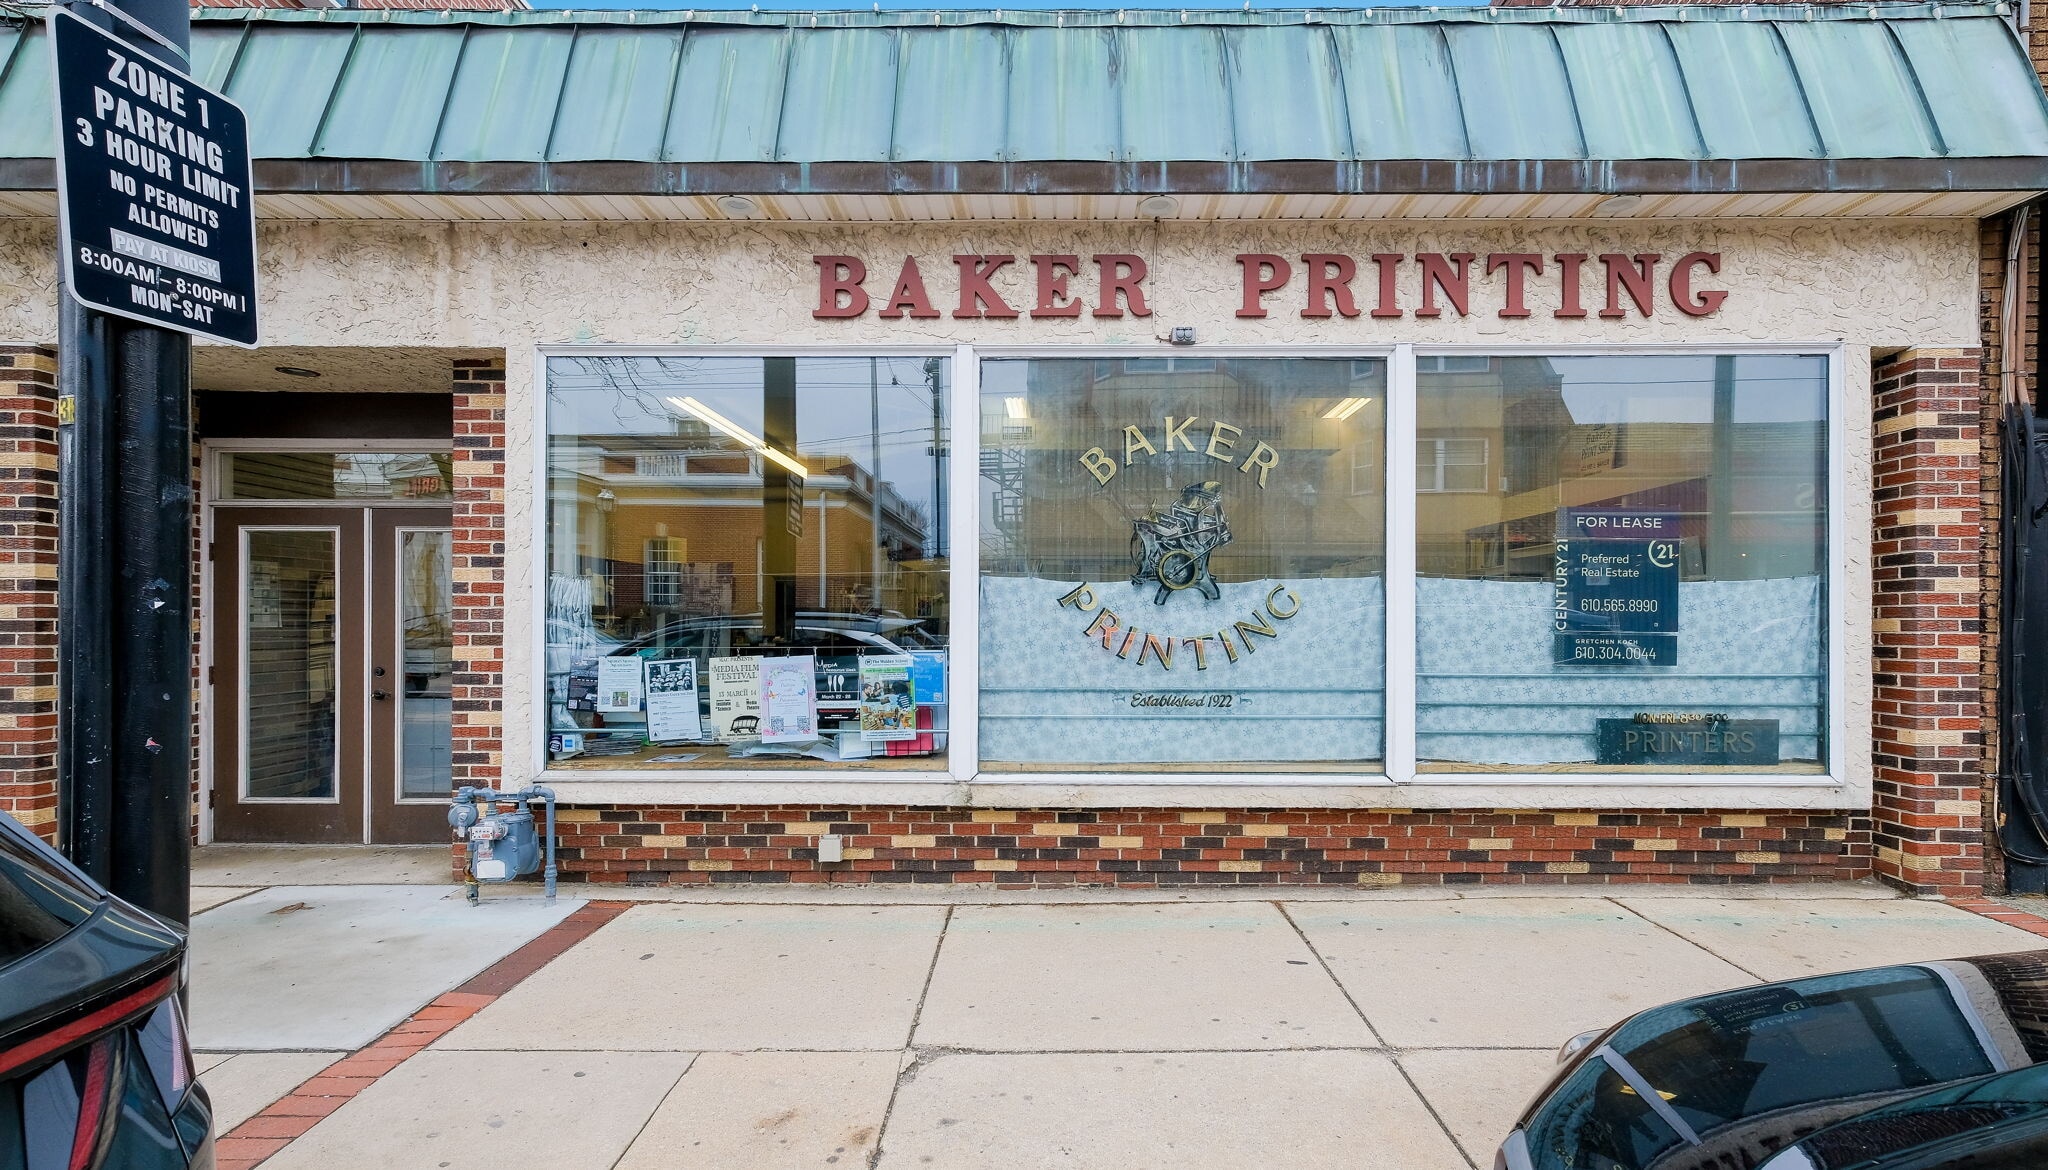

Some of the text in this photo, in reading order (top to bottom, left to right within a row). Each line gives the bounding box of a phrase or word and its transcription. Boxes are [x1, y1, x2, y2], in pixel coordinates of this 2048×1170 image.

[107, 49, 209, 129] ZONE 1
[94, 86, 224, 174] PARKING
[76, 117, 240, 208] 3 HOUR LIMIT
[110, 169, 219, 229] NO PERMITS
[128, 203, 208, 248] ALLOWED
[113, 233, 219, 279] PAY AT KIOSK
[80, 247, 155, 285] 8:00AM
[176, 278, 236, 310] 8:00PM
[812, 251, 1729, 318] BAKER PRINTING
[131, 284, 214, 324] MON-SAT
[1079, 415, 1280, 489] BAKER
[1576, 516, 1662, 529] FOR LEASE
[1581, 553, 1630, 564] Preferred
[1581, 567, 1640, 578] Real Estate
[1555, 538, 1568, 631] CENTURY 21
[1581, 598, 1658, 613] 610.565.8990
[1056, 581, 1301, 671] PRINTING
[714, 665, 739, 673] MEDIA
[740, 664, 760, 672] FILM
[1575, 646, 1656, 660] 610.304.0044
[716, 672, 758, 680] FESTIVAL
[727, 689, 748, 697] MARCH
[1131, 692, 1233, 708] Established 1922
[1623, 730, 1757, 753] PRINTERS
